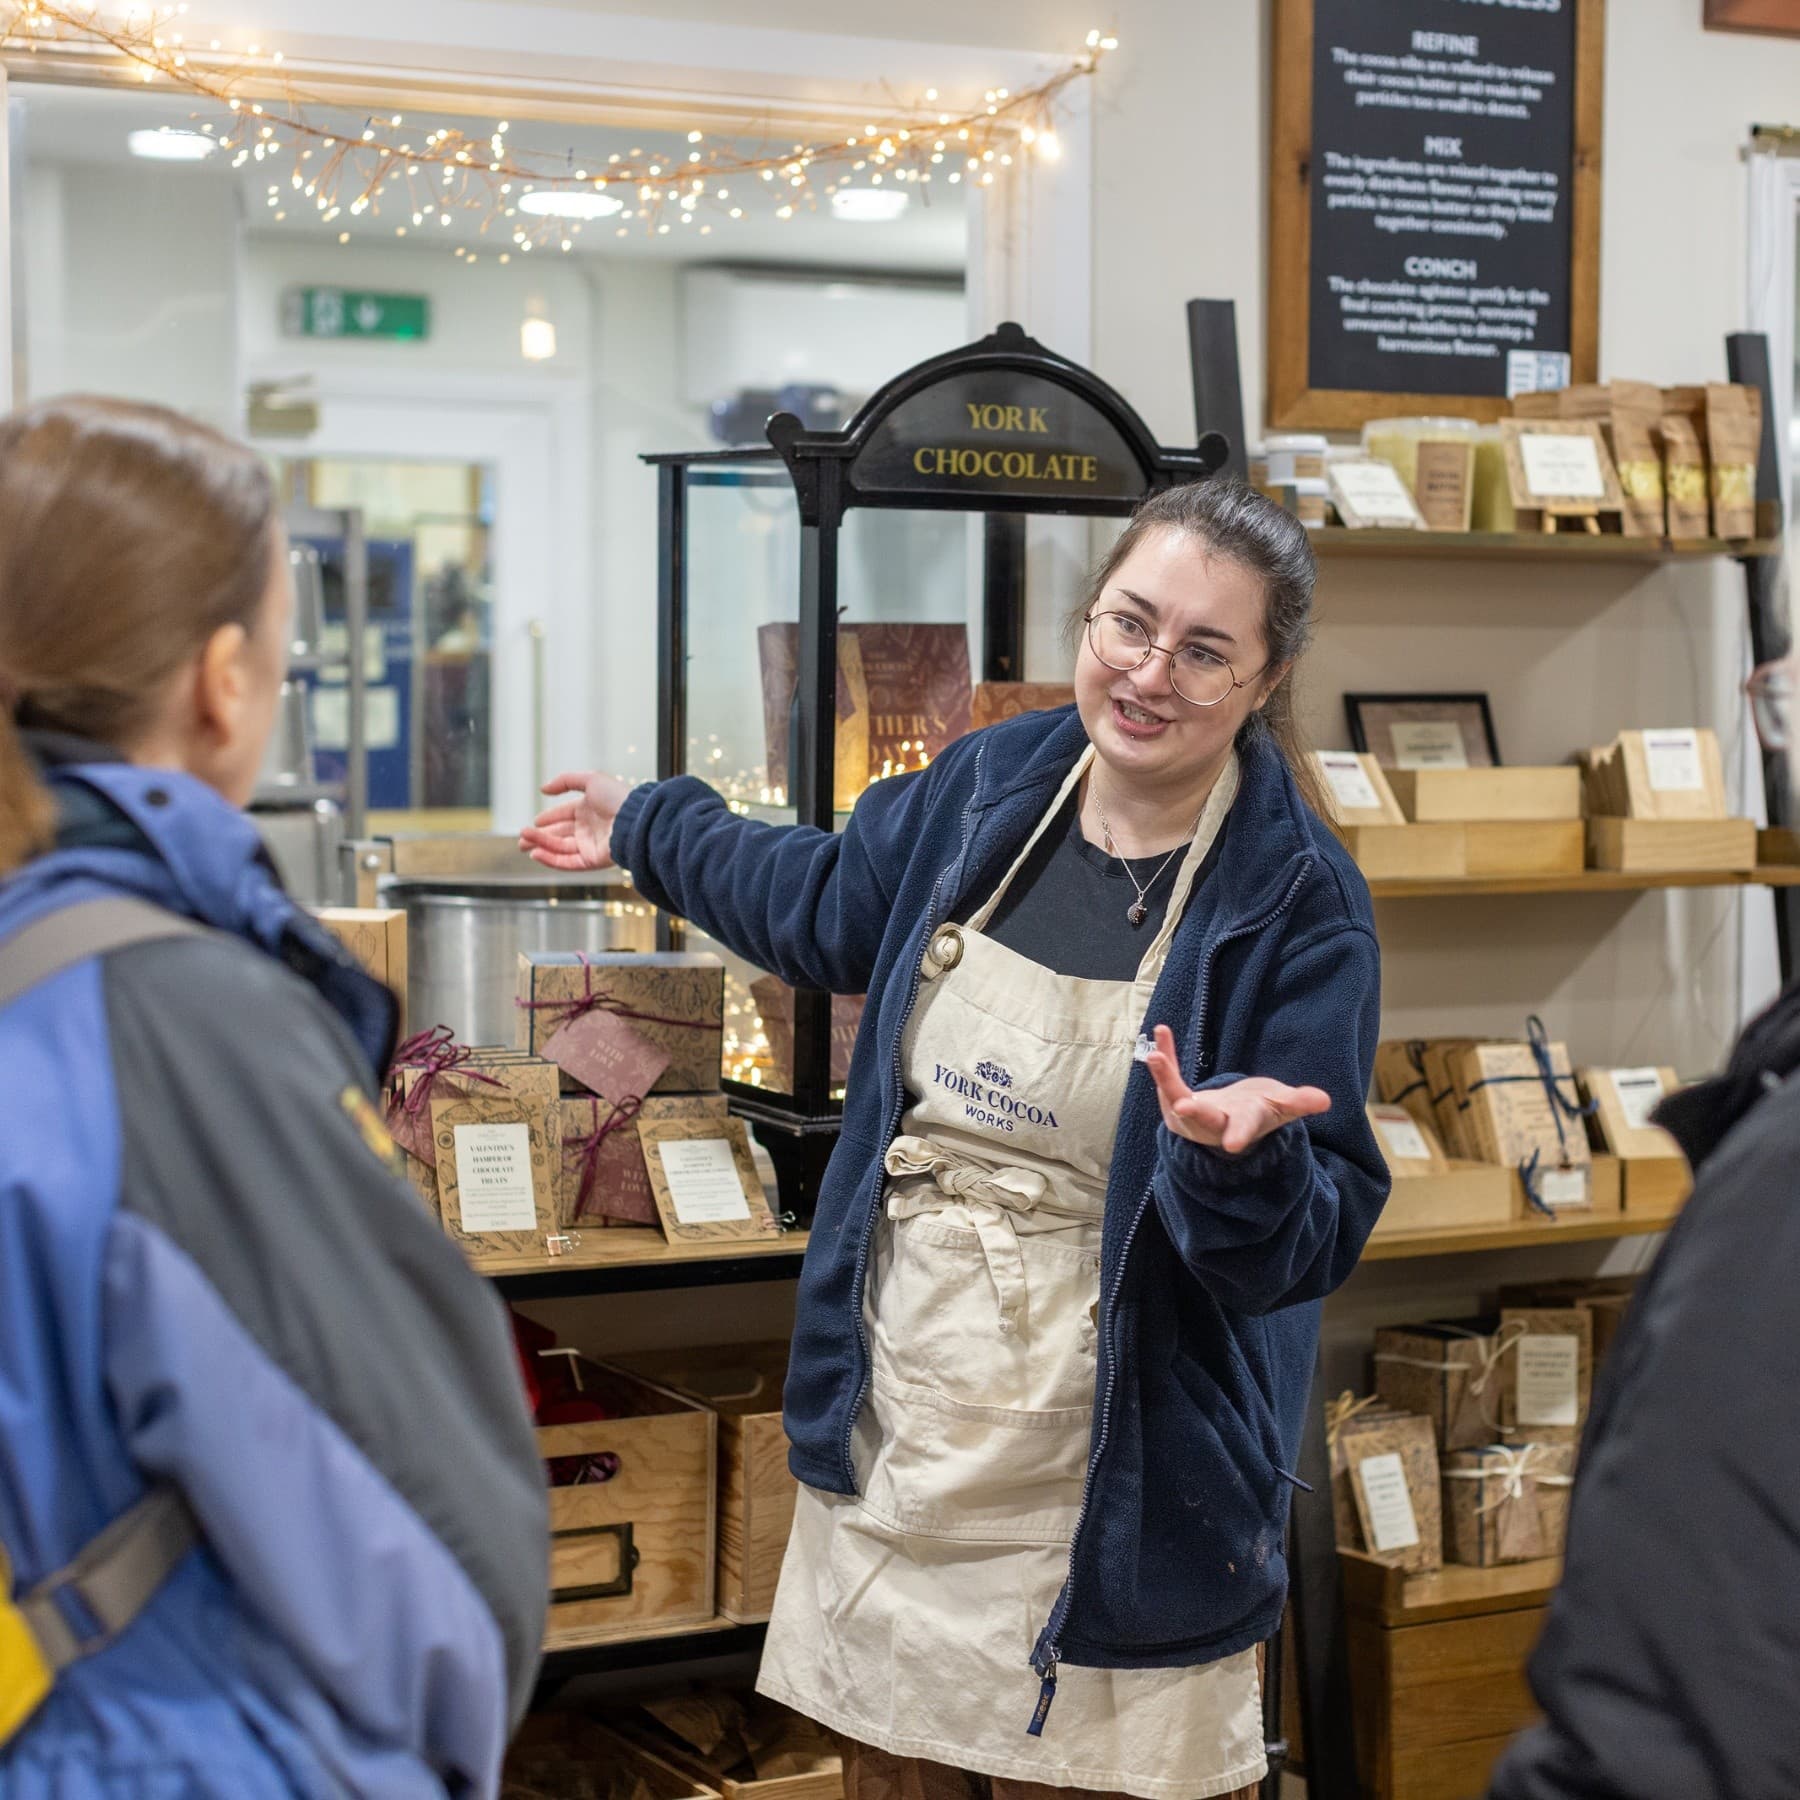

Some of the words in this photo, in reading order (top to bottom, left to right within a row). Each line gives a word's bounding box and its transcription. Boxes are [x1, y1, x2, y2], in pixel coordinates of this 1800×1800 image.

[1411, 30, 1479, 56] REFINE
[1424, 135, 1463, 158] MIX
[1403, 257, 1477, 280] CONCH
[967, 403, 1048, 433] YORK
[913, 447, 1097, 482] CHOCOLATE
[933, 1063, 982, 1101] YORK
[988, 1090, 1059, 1128] COCOA
[965, 1104, 1014, 1132] WORKS
[469, 1144, 515, 1153] VALENTINE'S
[472, 1155, 501, 1163] HAMPER
[472, 1166, 514, 1174] CHOCOLATE
[481, 1177, 508, 1185] TREATS
